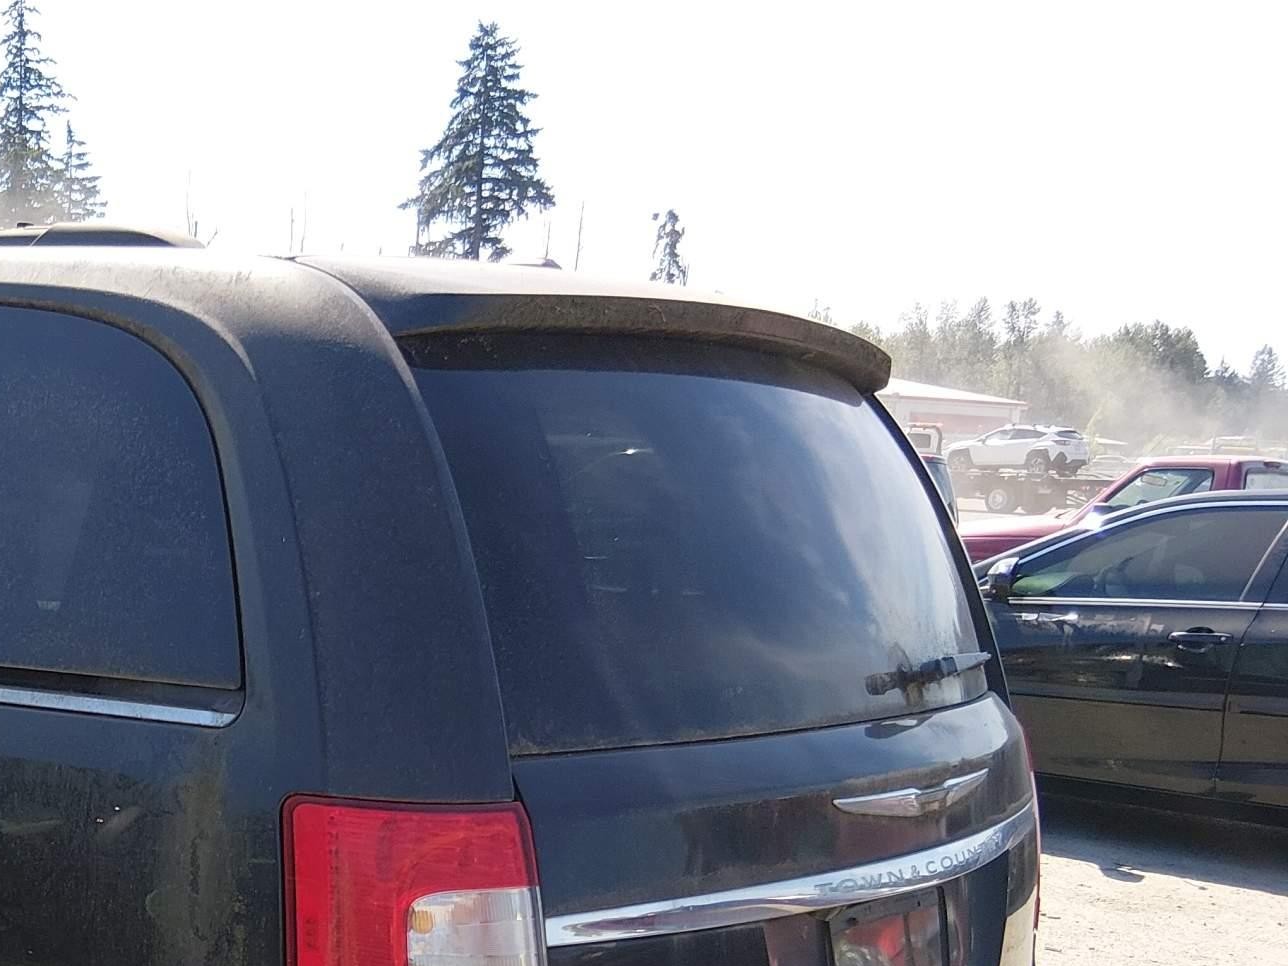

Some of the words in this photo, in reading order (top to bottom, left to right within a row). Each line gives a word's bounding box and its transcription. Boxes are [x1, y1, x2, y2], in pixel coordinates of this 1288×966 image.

[814, 868, 905, 894] TOWN
[911, 864, 921, 878] &
[925, 832, 1003, 874] COUNTY
